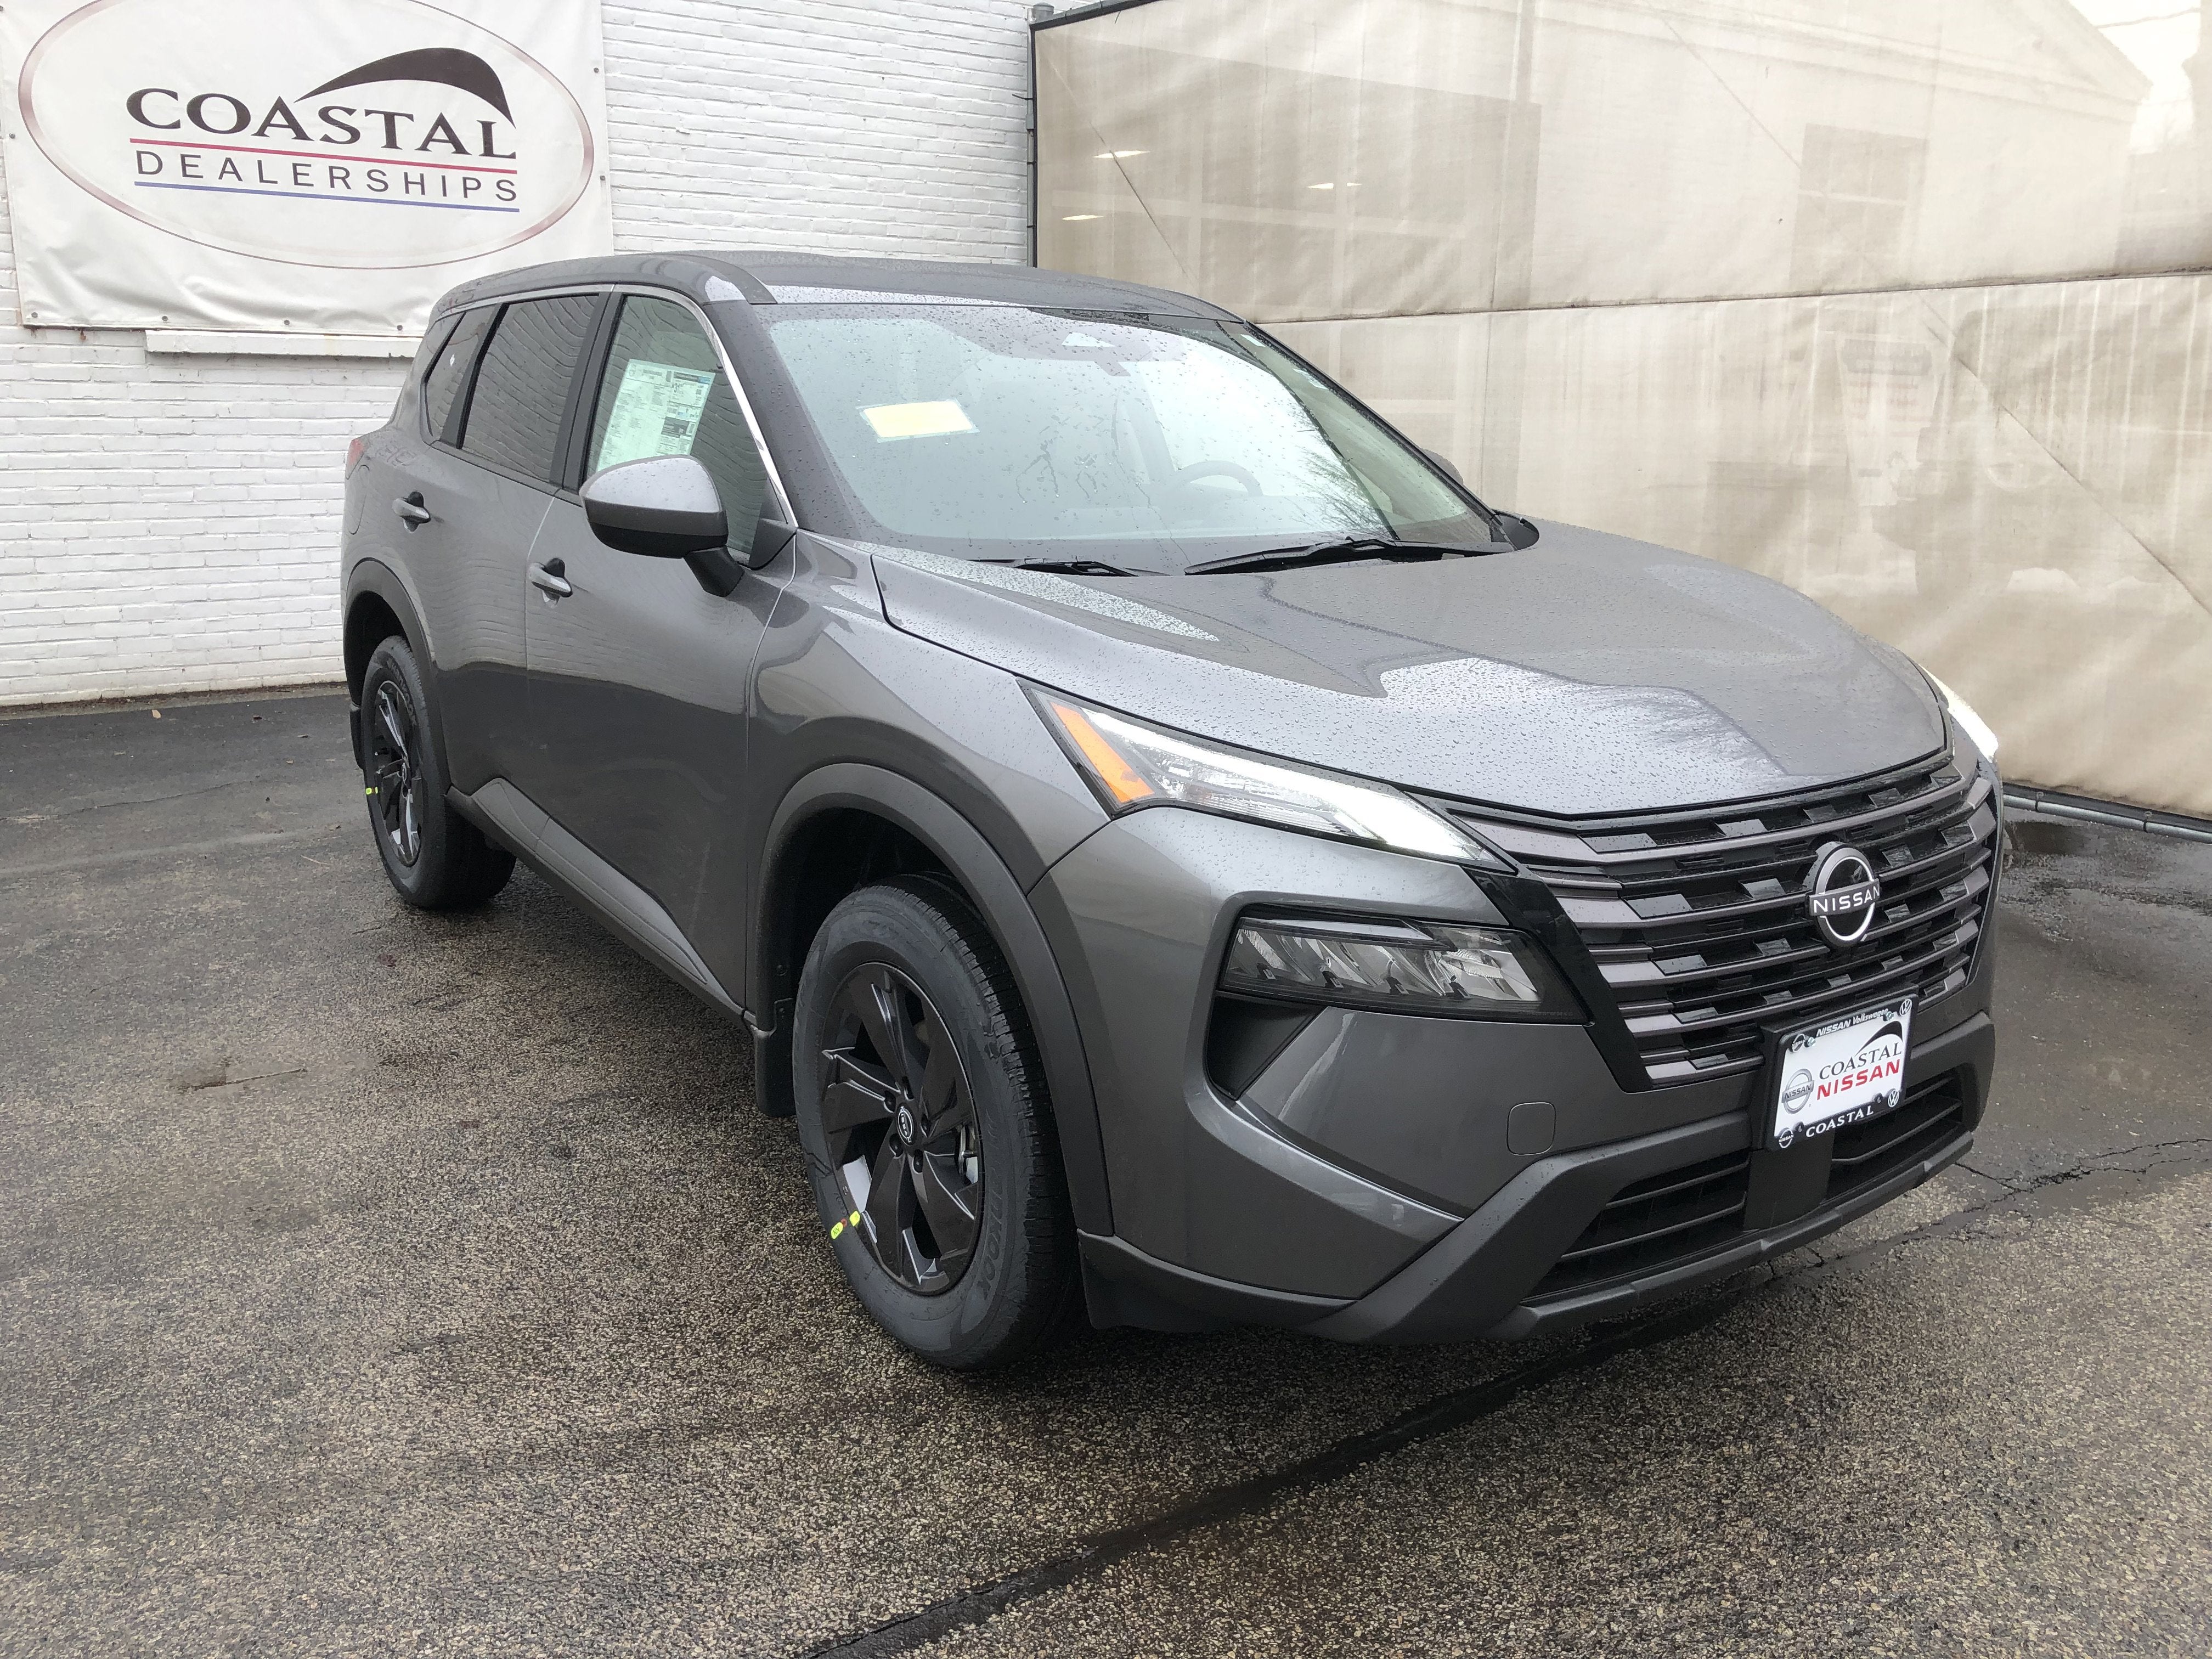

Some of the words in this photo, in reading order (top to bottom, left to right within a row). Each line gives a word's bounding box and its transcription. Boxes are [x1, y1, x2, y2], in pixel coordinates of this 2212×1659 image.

[126, 88, 517, 160] COASTAL
[136, 150, 517, 202] DEALERSHIPS
[1813, 883, 1880, 913] NISSAN
[1816, 1019, 1851, 1037] NISSAN
[1853, 1008, 1889, 1024] Volkswagen
[1819, 1042, 1902, 1080] COASTAL
[1785, 1084, 1812, 1099] NISSAN
[1817, 1059, 1900, 1101] NISSAN
[1805, 1105, 1874, 1138] COASTAL
